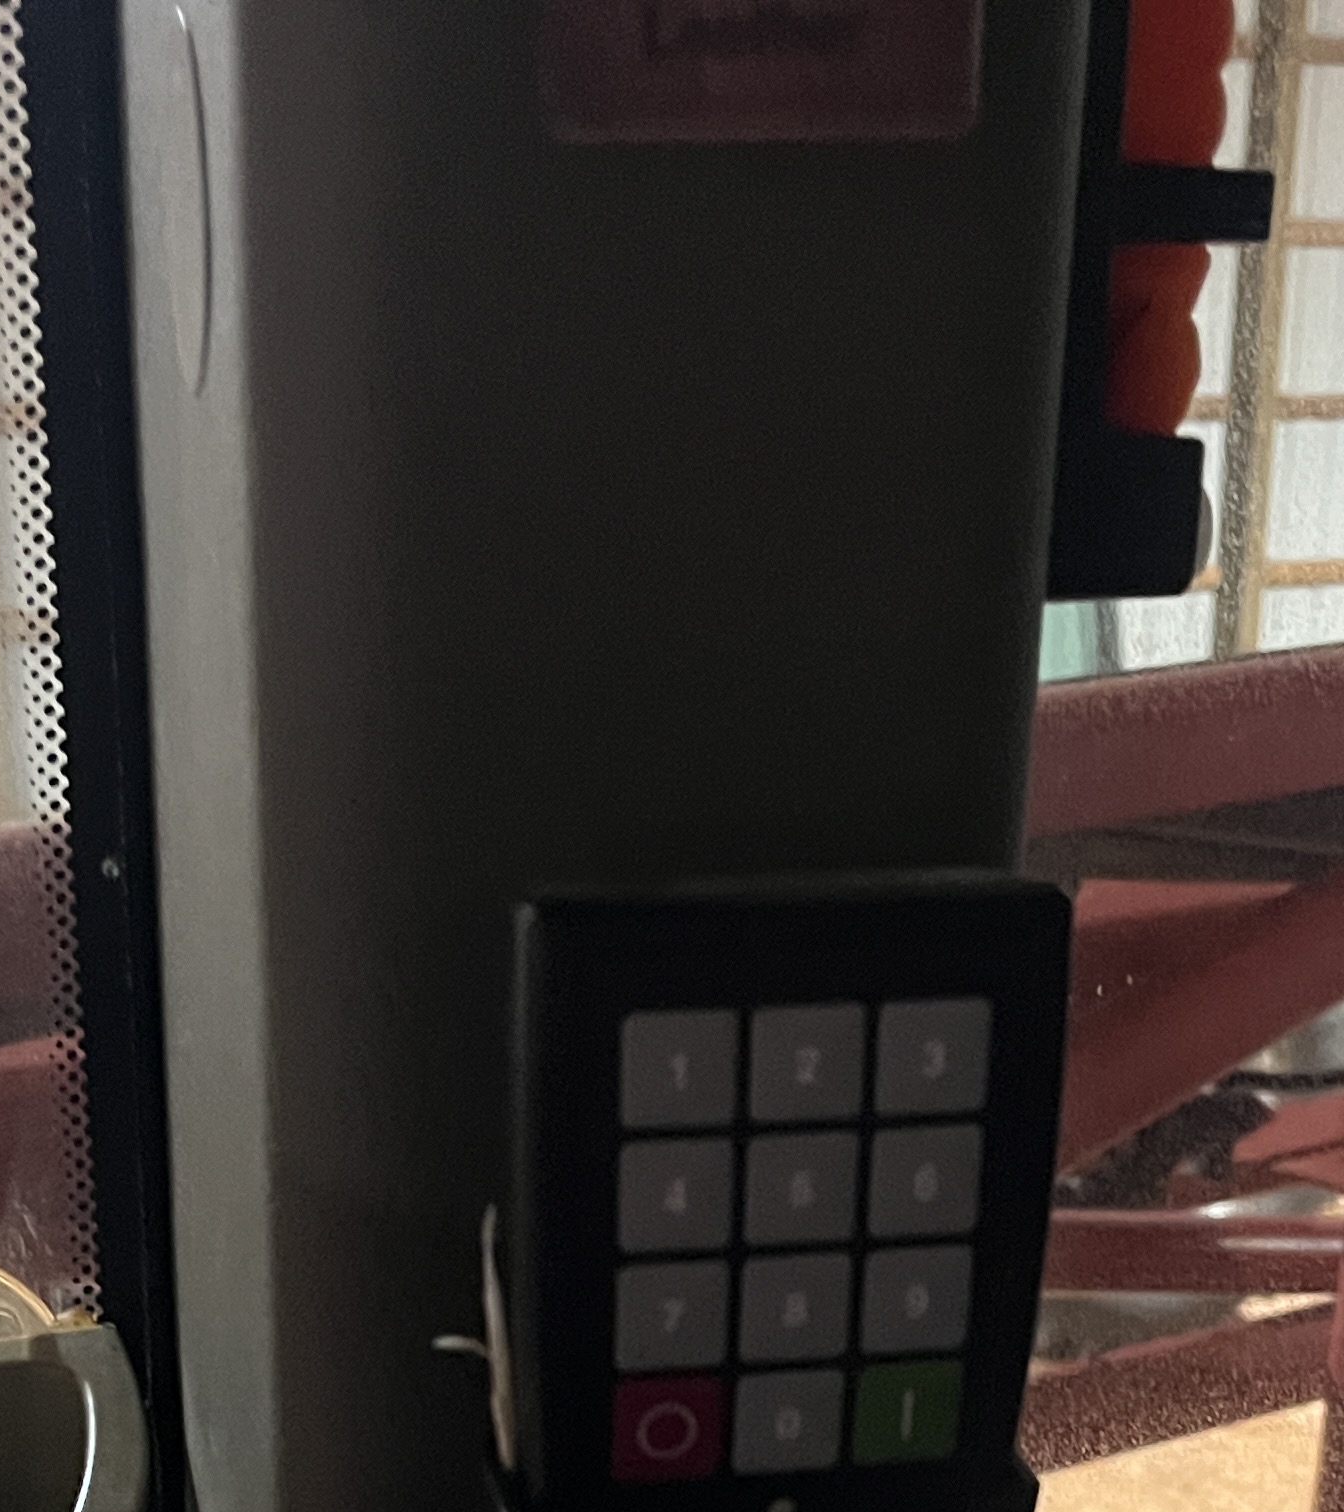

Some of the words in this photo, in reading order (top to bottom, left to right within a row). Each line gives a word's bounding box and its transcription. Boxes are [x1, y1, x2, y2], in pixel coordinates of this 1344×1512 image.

[671, 1050, 688, 1090] 1
[794, 1044, 821, 1086] 2
[922, 1037, 947, 1079] 3
[663, 1175, 688, 1215] 4
[788, 1167, 815, 1209] 5
[913, 1161, 939, 1203] 6
[662, 1296, 685, 1333] 7
[782, 1290, 809, 1329] 8
[905, 1281, 930, 1320] 9
[774, 1405, 802, 1441] 0
